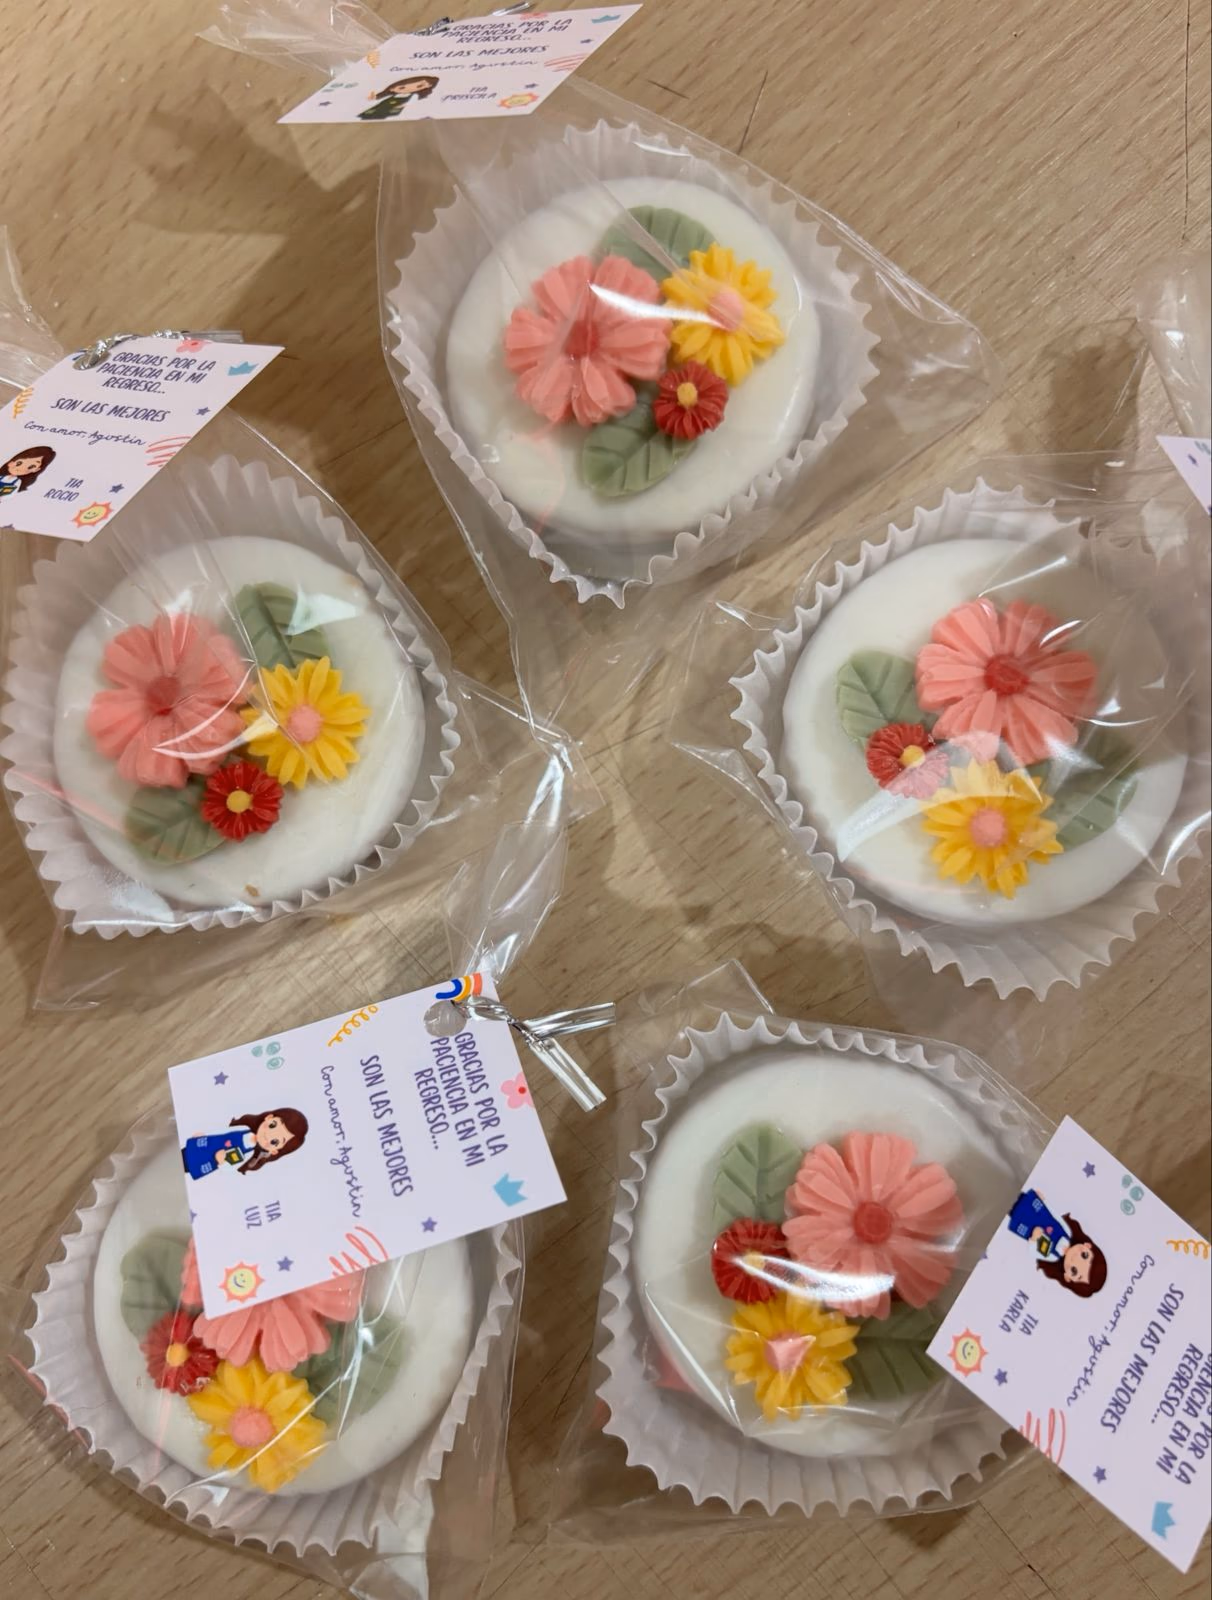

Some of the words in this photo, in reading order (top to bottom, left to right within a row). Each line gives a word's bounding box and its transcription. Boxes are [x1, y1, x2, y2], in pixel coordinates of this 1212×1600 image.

[442, 28, 517, 38] PACIENCIA
[524, 25, 544, 33] EN
[452, 22, 514, 31] GRACIAS
[518, 20, 549, 28] POR
[409, 52, 442, 60] SON
[445, 50, 475, 58] LAS
[477, 45, 550, 56] MEJORES
[96, 362, 162, 380] PACIENCIA
[164, 368, 187, 382] EN
[188, 372, 207, 385] MI
[112, 351, 166, 367] GRACIAS
[167, 357, 197, 371] POR
[198, 360, 217, 372] LA
[50, 398, 83, 411] SON
[80, 401, 108, 415] LAS
[107, 405, 171, 423] MEJORES
[24, 421, 50, 432] Con
[43, 488, 80, 502] ROCIO
[64, 478, 84, 489] TIA
[359, 1054, 385, 1088] SON
[429, 1036, 469, 1116] PACIENCIA
[453, 1031, 490, 1096] GRACIAS
[320, 1064, 334, 1098] Con
[368, 1091, 395, 1121] LAS
[473, 1096, 501, 1131] POR
[452, 1119, 478, 1143] EN
[462, 1144, 486, 1168] MI
[486, 1133, 508, 1158] LA
[377, 1123, 414, 1198] MEJORES
[244, 1205, 263, 1230] LUZ
[264, 1200, 283, 1223] TIA
[1131, 1253, 1155, 1286] Con
[998, 1288, 1030, 1334] KARLA
[1157, 1282, 1185, 1322] SON
[1019, 1314, 1039, 1337] TIA
[1140, 1319, 1167, 1355] LAS
[1100, 1353, 1149, 1434] MEJORES
[1168, 1420, 1191, 1448] EN
[1156, 1446, 1178, 1475] MI
[1175, 1461, 1197, 1485] LA
